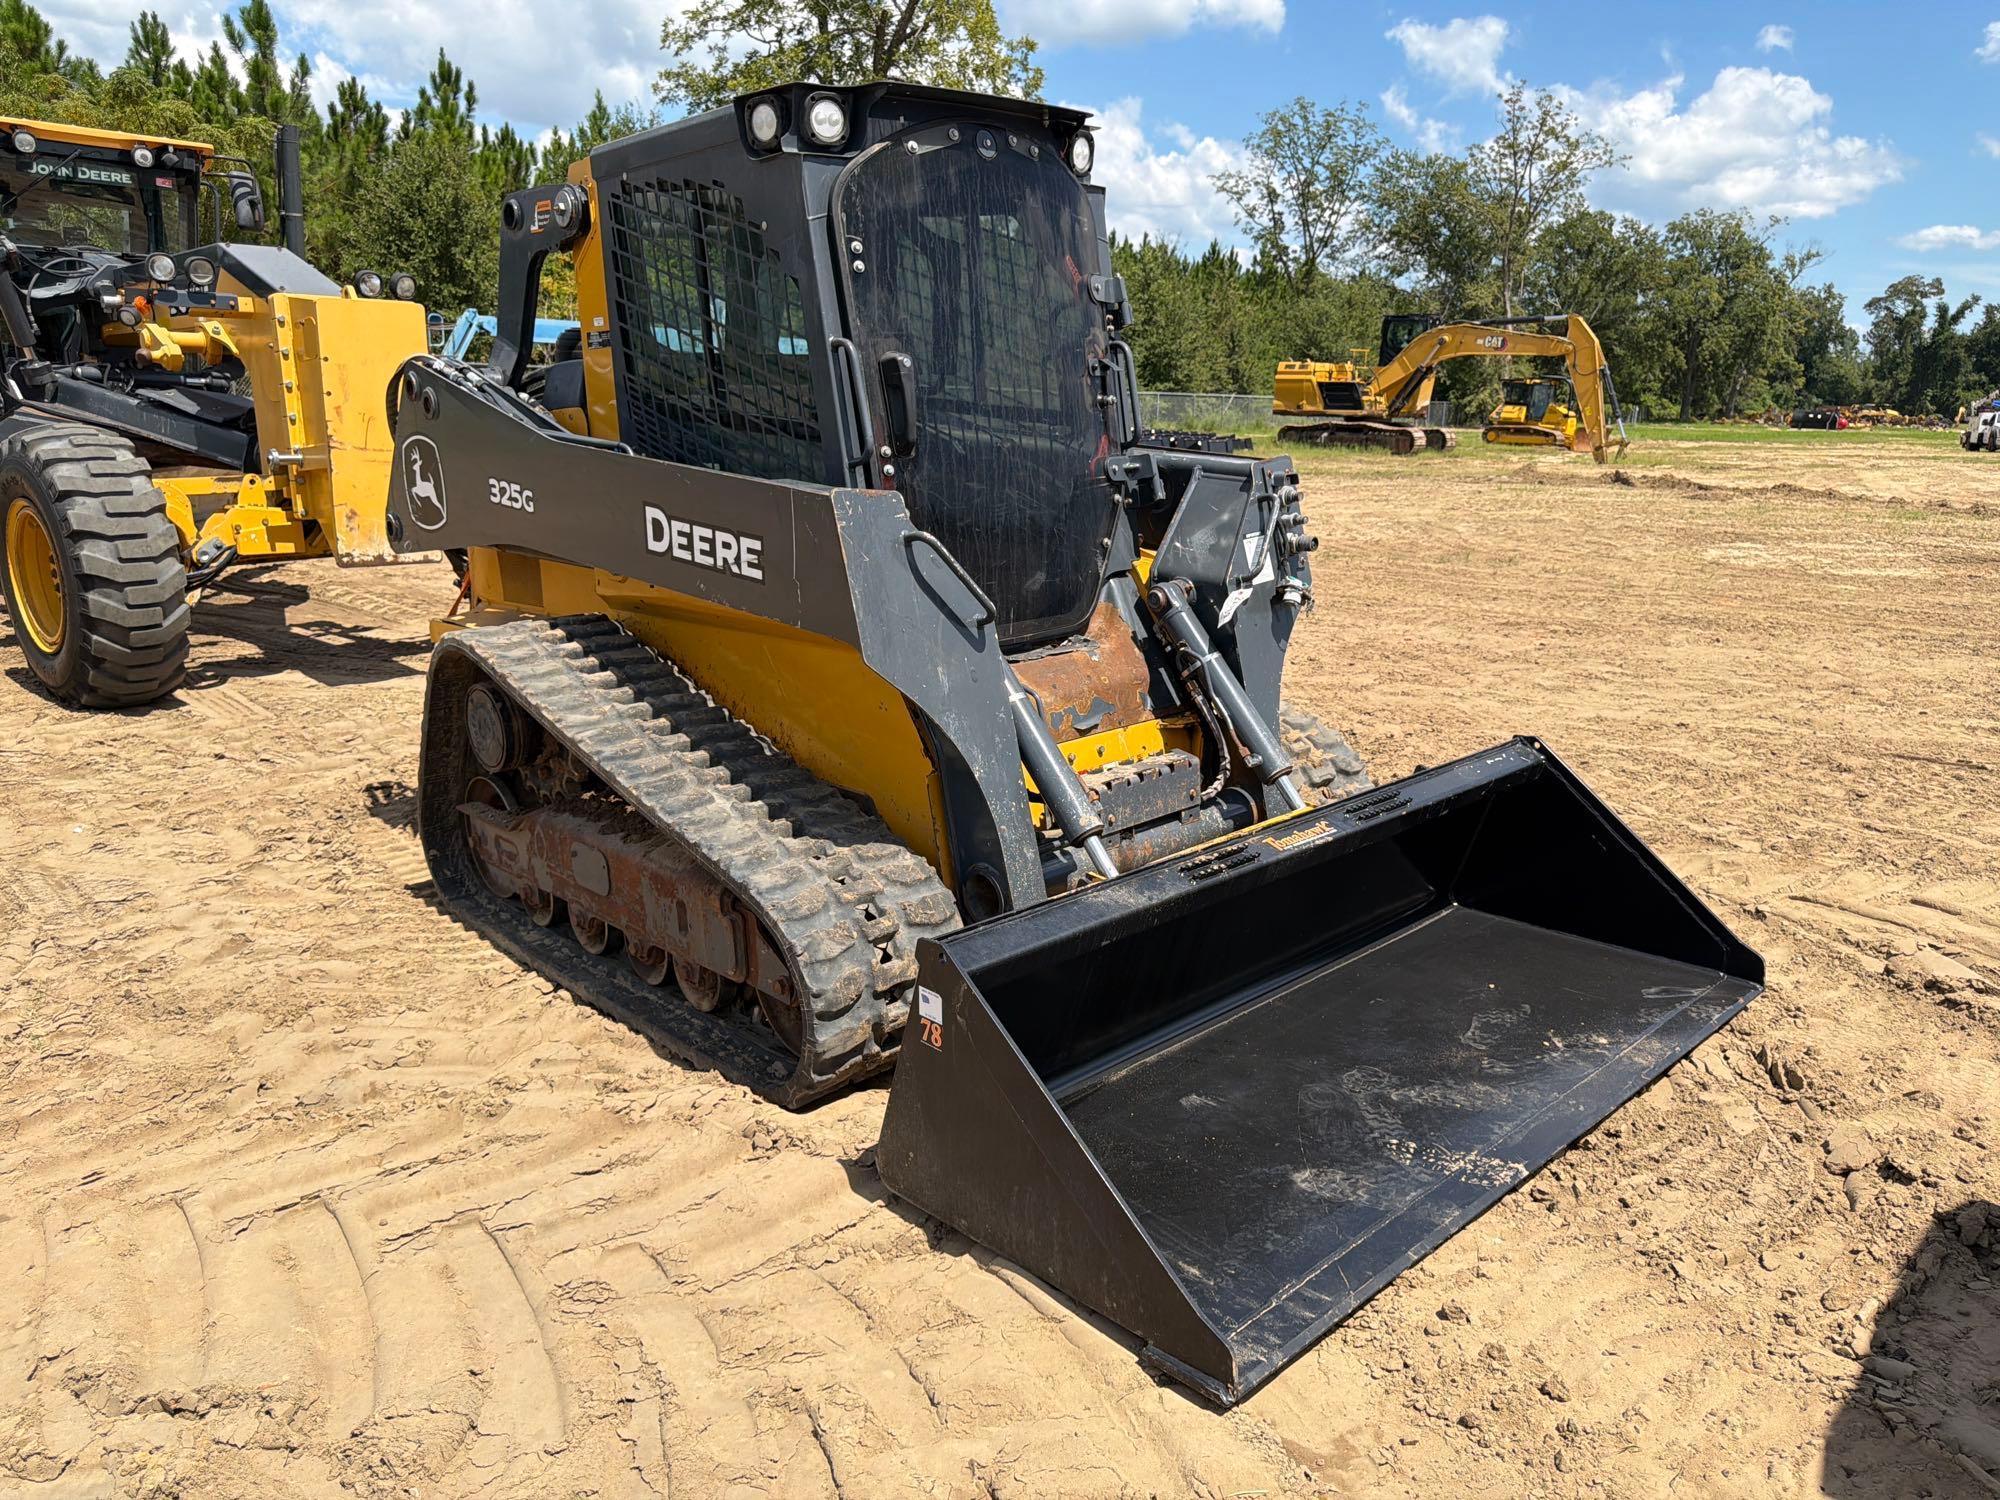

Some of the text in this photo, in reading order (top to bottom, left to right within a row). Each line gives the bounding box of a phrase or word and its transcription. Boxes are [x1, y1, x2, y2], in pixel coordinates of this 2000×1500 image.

[28, 161, 132, 184] JOHN DEERE
[1485, 336, 1504, 348] CAT
[488, 478, 534, 513] 325G
[645, 505, 763, 580] DEERE
[920, 1017, 942, 1047] 78
